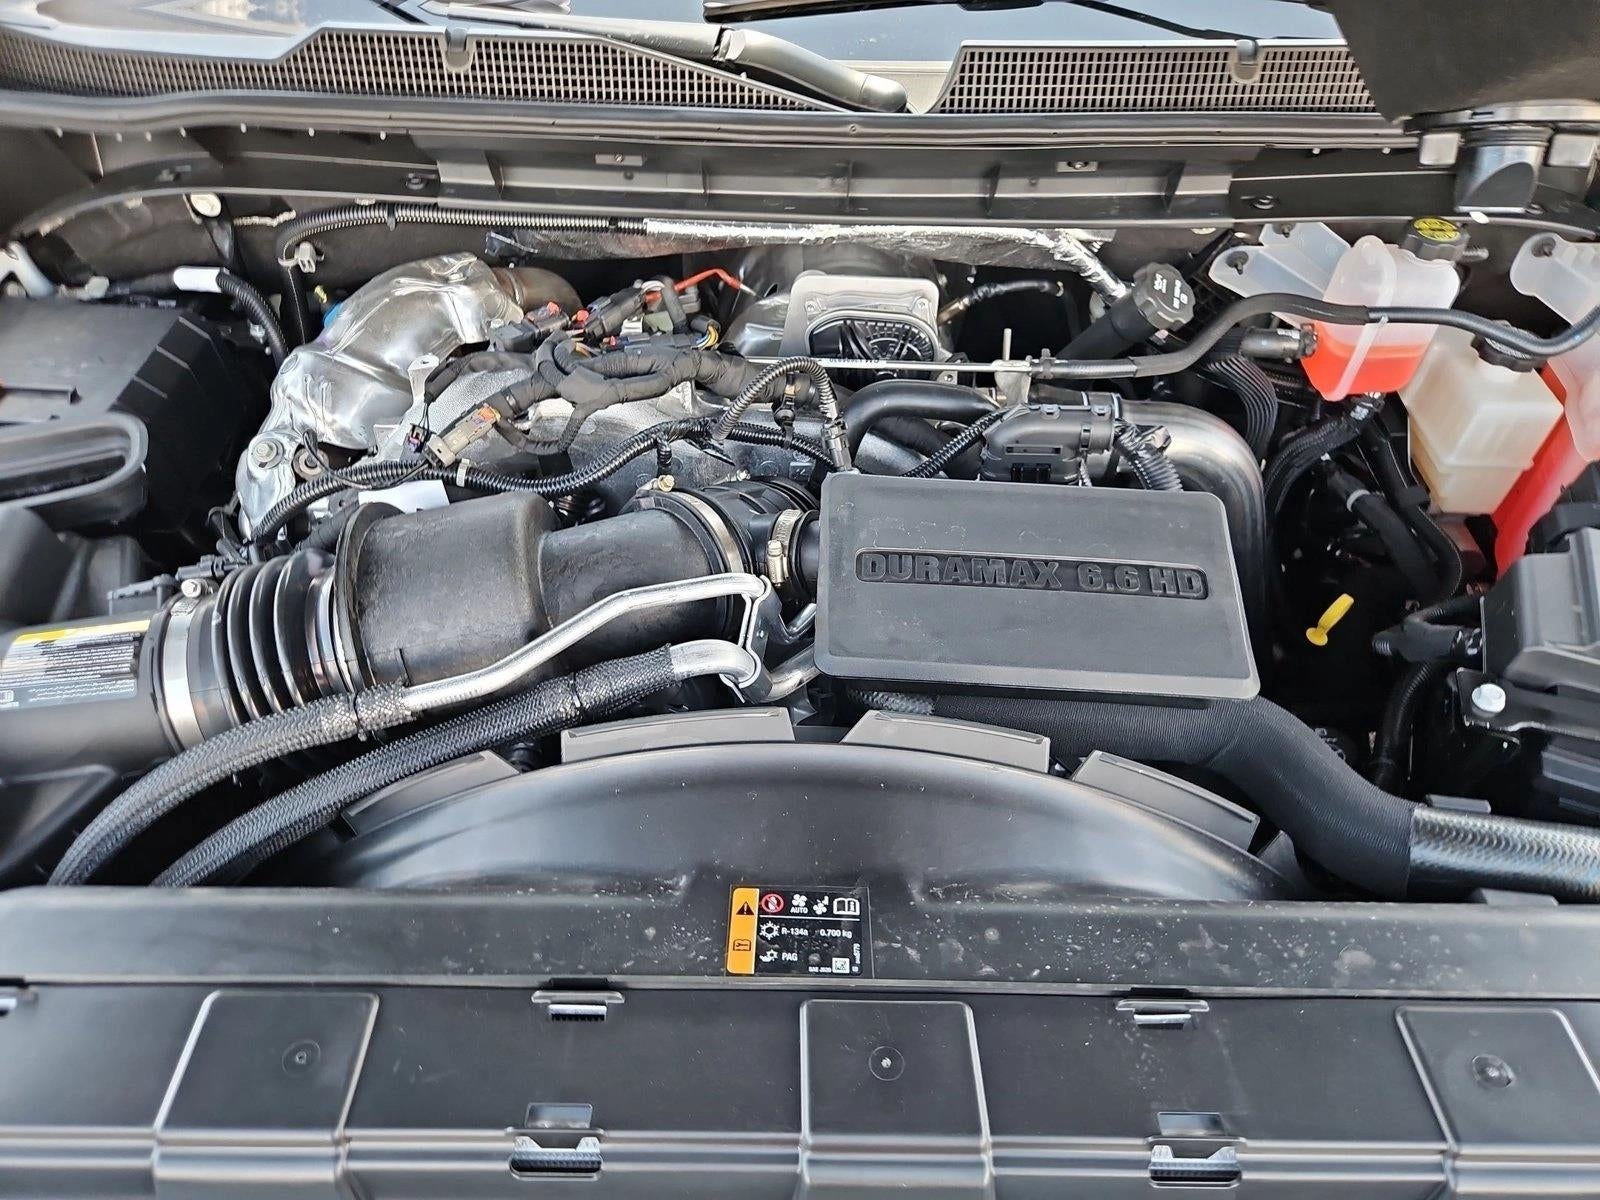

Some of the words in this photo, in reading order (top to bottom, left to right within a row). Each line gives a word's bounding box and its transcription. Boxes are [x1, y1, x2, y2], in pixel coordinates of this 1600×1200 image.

[861, 554, 1062, 588] DURAMAX
[1077, 563, 1141, 591] 6.6
[1148, 567, 1205, 597] HD
[790, 906, 808, 914] AUTO
[781, 927, 809, 936] R-134a
[819, 928, 841, 937] 0.700
[842, 929, 853, 939] kg
[781, 952, 798, 961] PAG
